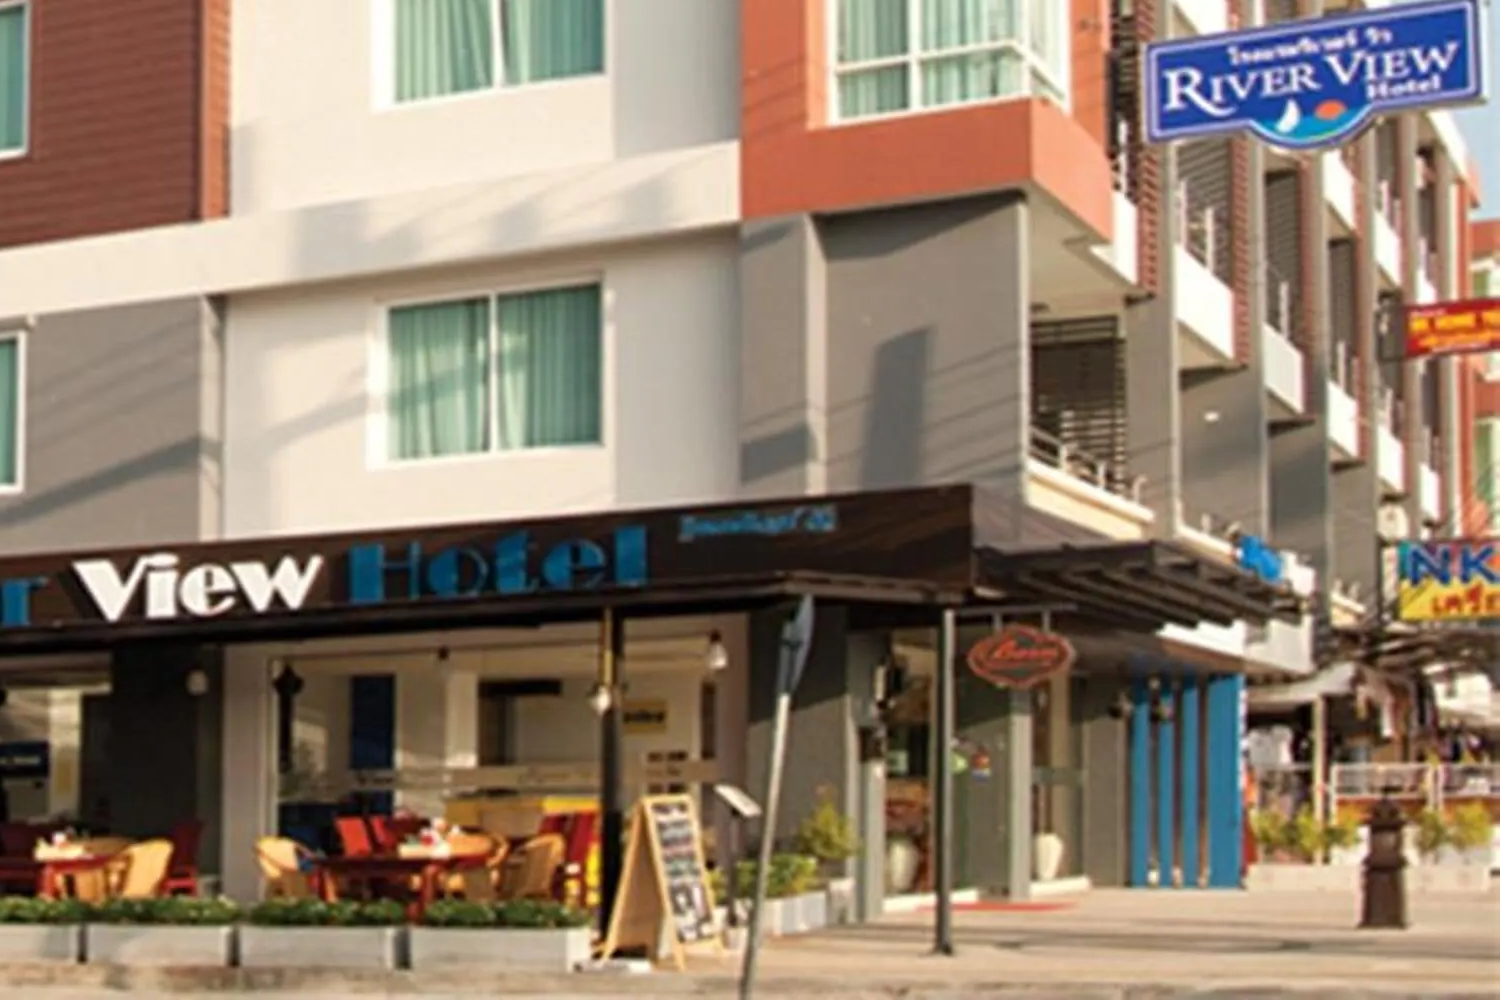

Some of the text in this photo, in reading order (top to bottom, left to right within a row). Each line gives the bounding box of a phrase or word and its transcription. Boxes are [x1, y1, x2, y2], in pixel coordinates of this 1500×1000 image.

[1162, 61, 1323, 118] RIVER
[1324, 39, 1460, 86] VIEW
[1366, 74, 1442, 100] Hotel
[71, 553, 324, 623] View
[348, 524, 650, 606] Hotel
